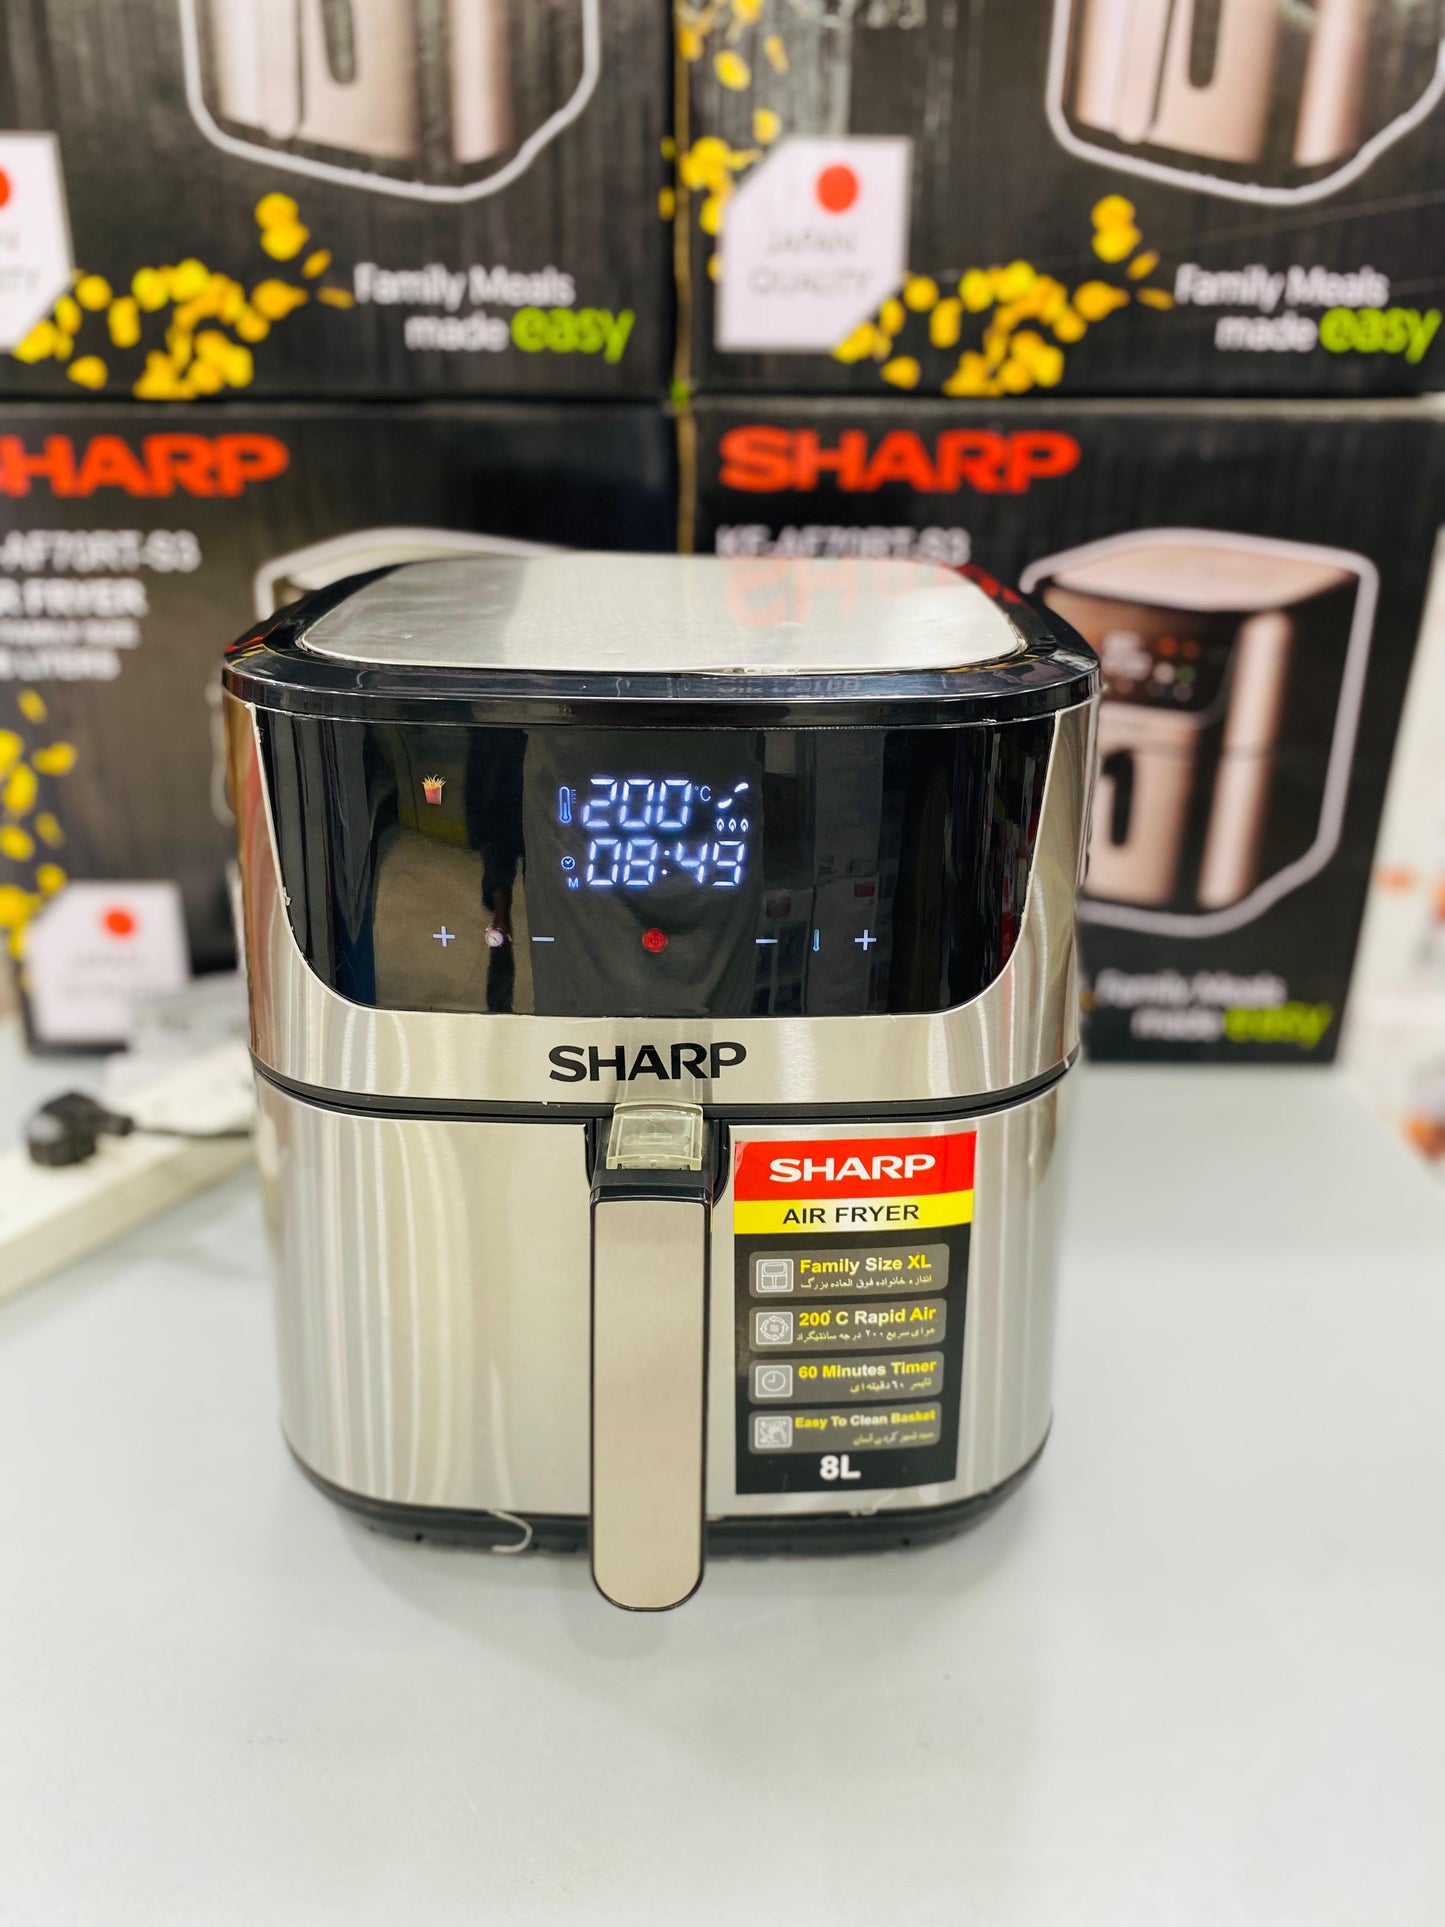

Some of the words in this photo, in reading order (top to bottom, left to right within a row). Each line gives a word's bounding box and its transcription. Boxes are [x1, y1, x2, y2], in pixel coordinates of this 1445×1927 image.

[354, 262, 467, 312] Family
[468, 264, 576, 308] Meals
[1174, 263, 1285, 313] Family
[1285, 265, 1390, 308] Meals
[404, 309, 510, 352] made
[511, 307, 635, 365] easy
[1214, 309, 1318, 353] made
[1319, 306, 1443, 364] easy
[0, 432, 290, 498] HARP
[718, 426, 1080, 494] SHARP
[582, 777, 693, 829] 200
[568, 877, 579, 889] M
[586, 838, 746, 887] 08:49
[548, 1041, 747, 1083] SHARP
[769, 1153, 936, 1183] SHARP
[782, 1207, 827, 1225] AIR
[835, 1204, 920, 1224] FRYER
[800, 1258, 860, 1275] Family
[865, 1256, 903, 1272] Size
[908, 1254, 932, 1269] XL
[854, 1308, 906, 1327] Rapid
[910, 1306, 937, 1321] Air
[798, 1366, 818, 1379] 60
[822, 1364, 887, 1378] Minutes
[890, 1361, 937, 1375] Timer
[794, 1416, 828, 1430] Easy
[831, 1415, 848, 1427] To
[850, 1414, 888, 1427] Clean
[890, 1409, 936, 1424] Basket
[819, 1453, 862, 1480] 8L
